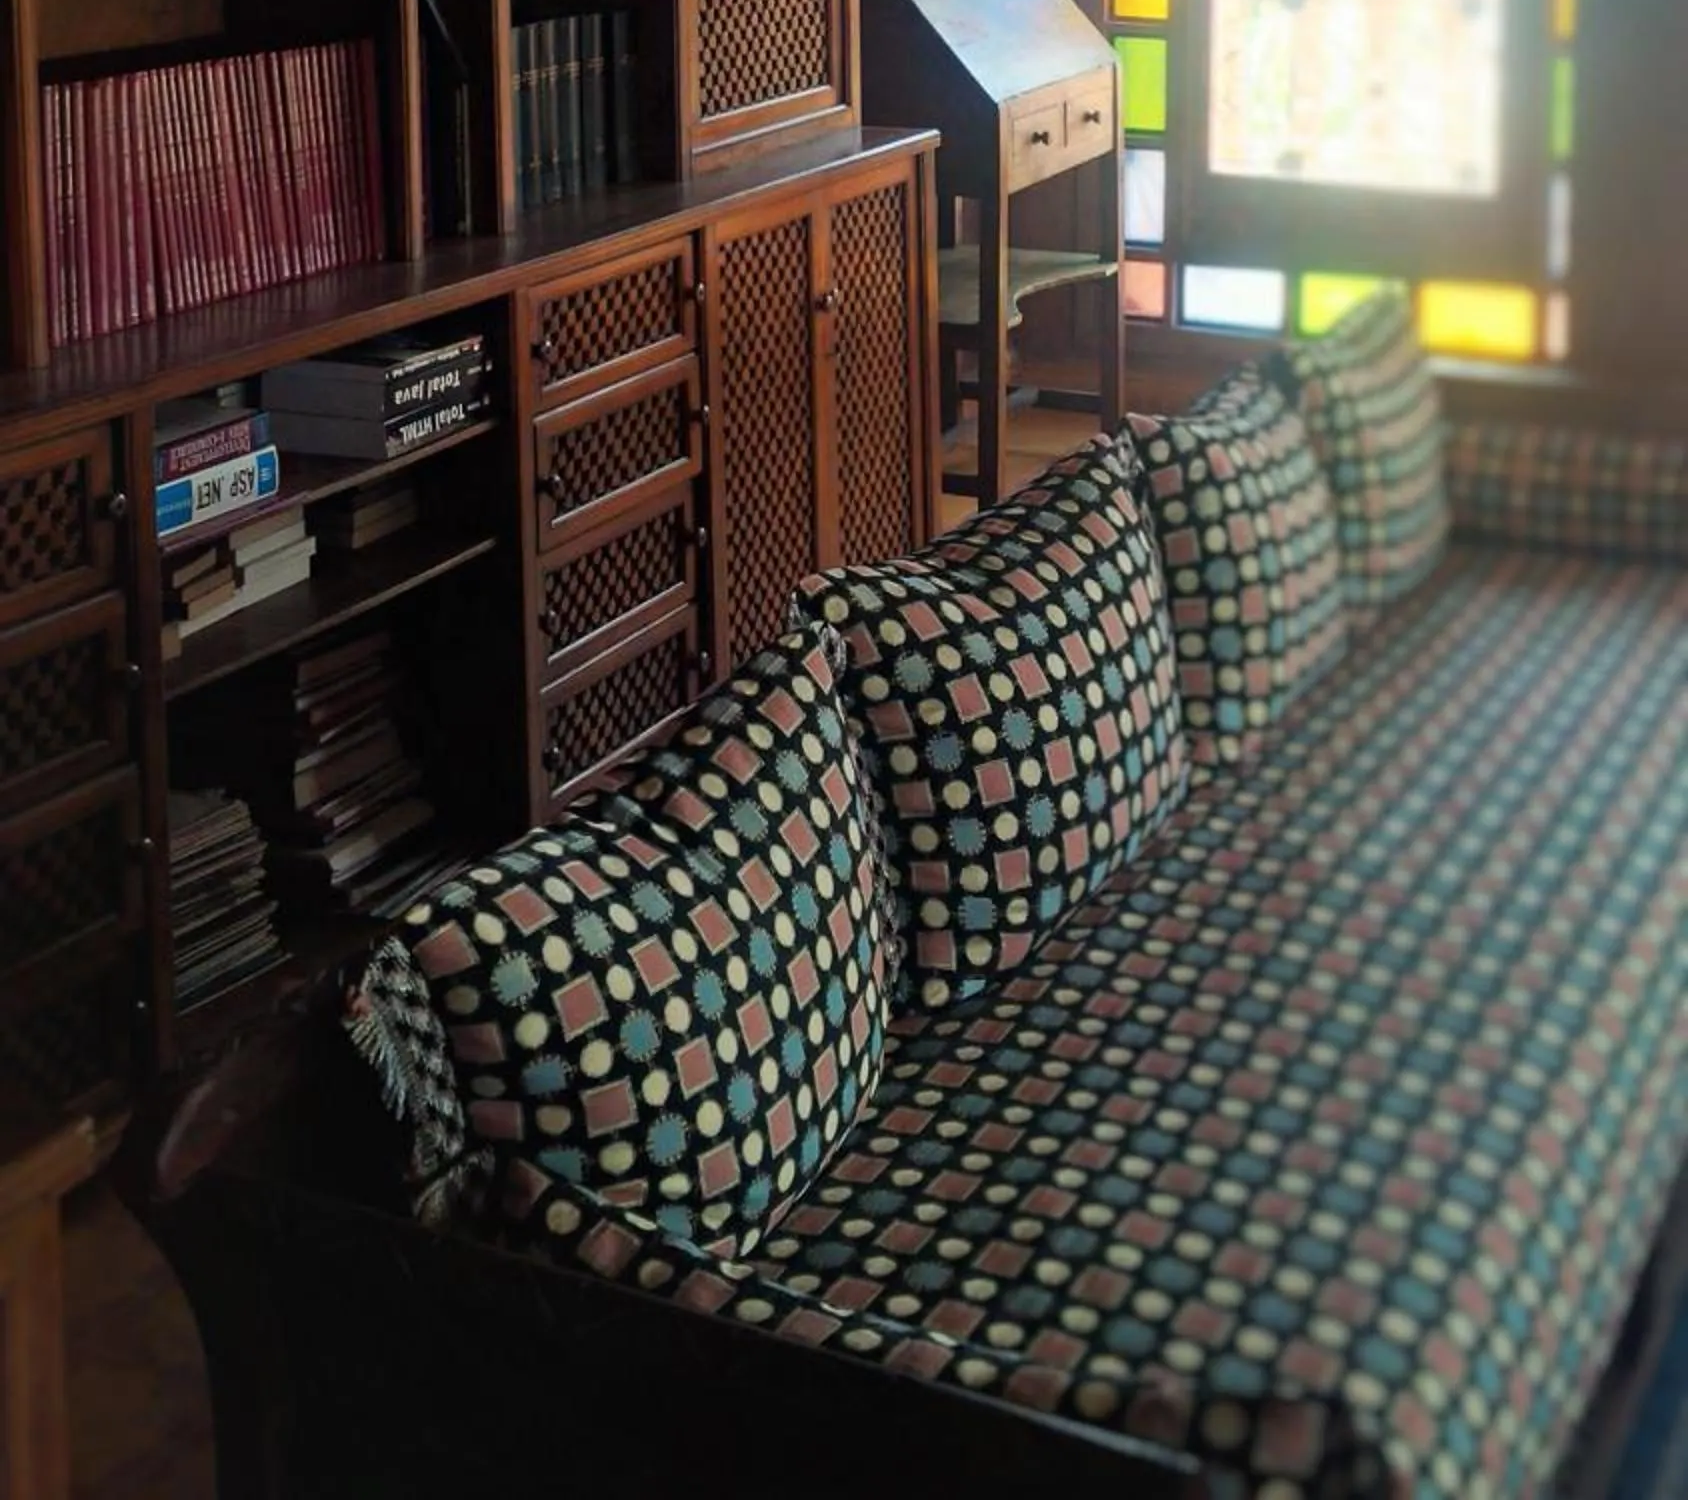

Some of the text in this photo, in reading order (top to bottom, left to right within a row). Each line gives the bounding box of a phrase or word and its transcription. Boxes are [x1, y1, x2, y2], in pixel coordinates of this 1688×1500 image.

[427, 369, 461, 401] Total
[399, 403, 466, 445] Total HTML
[195, 476, 225, 511] .NET
[229, 466, 255, 497] ASP
